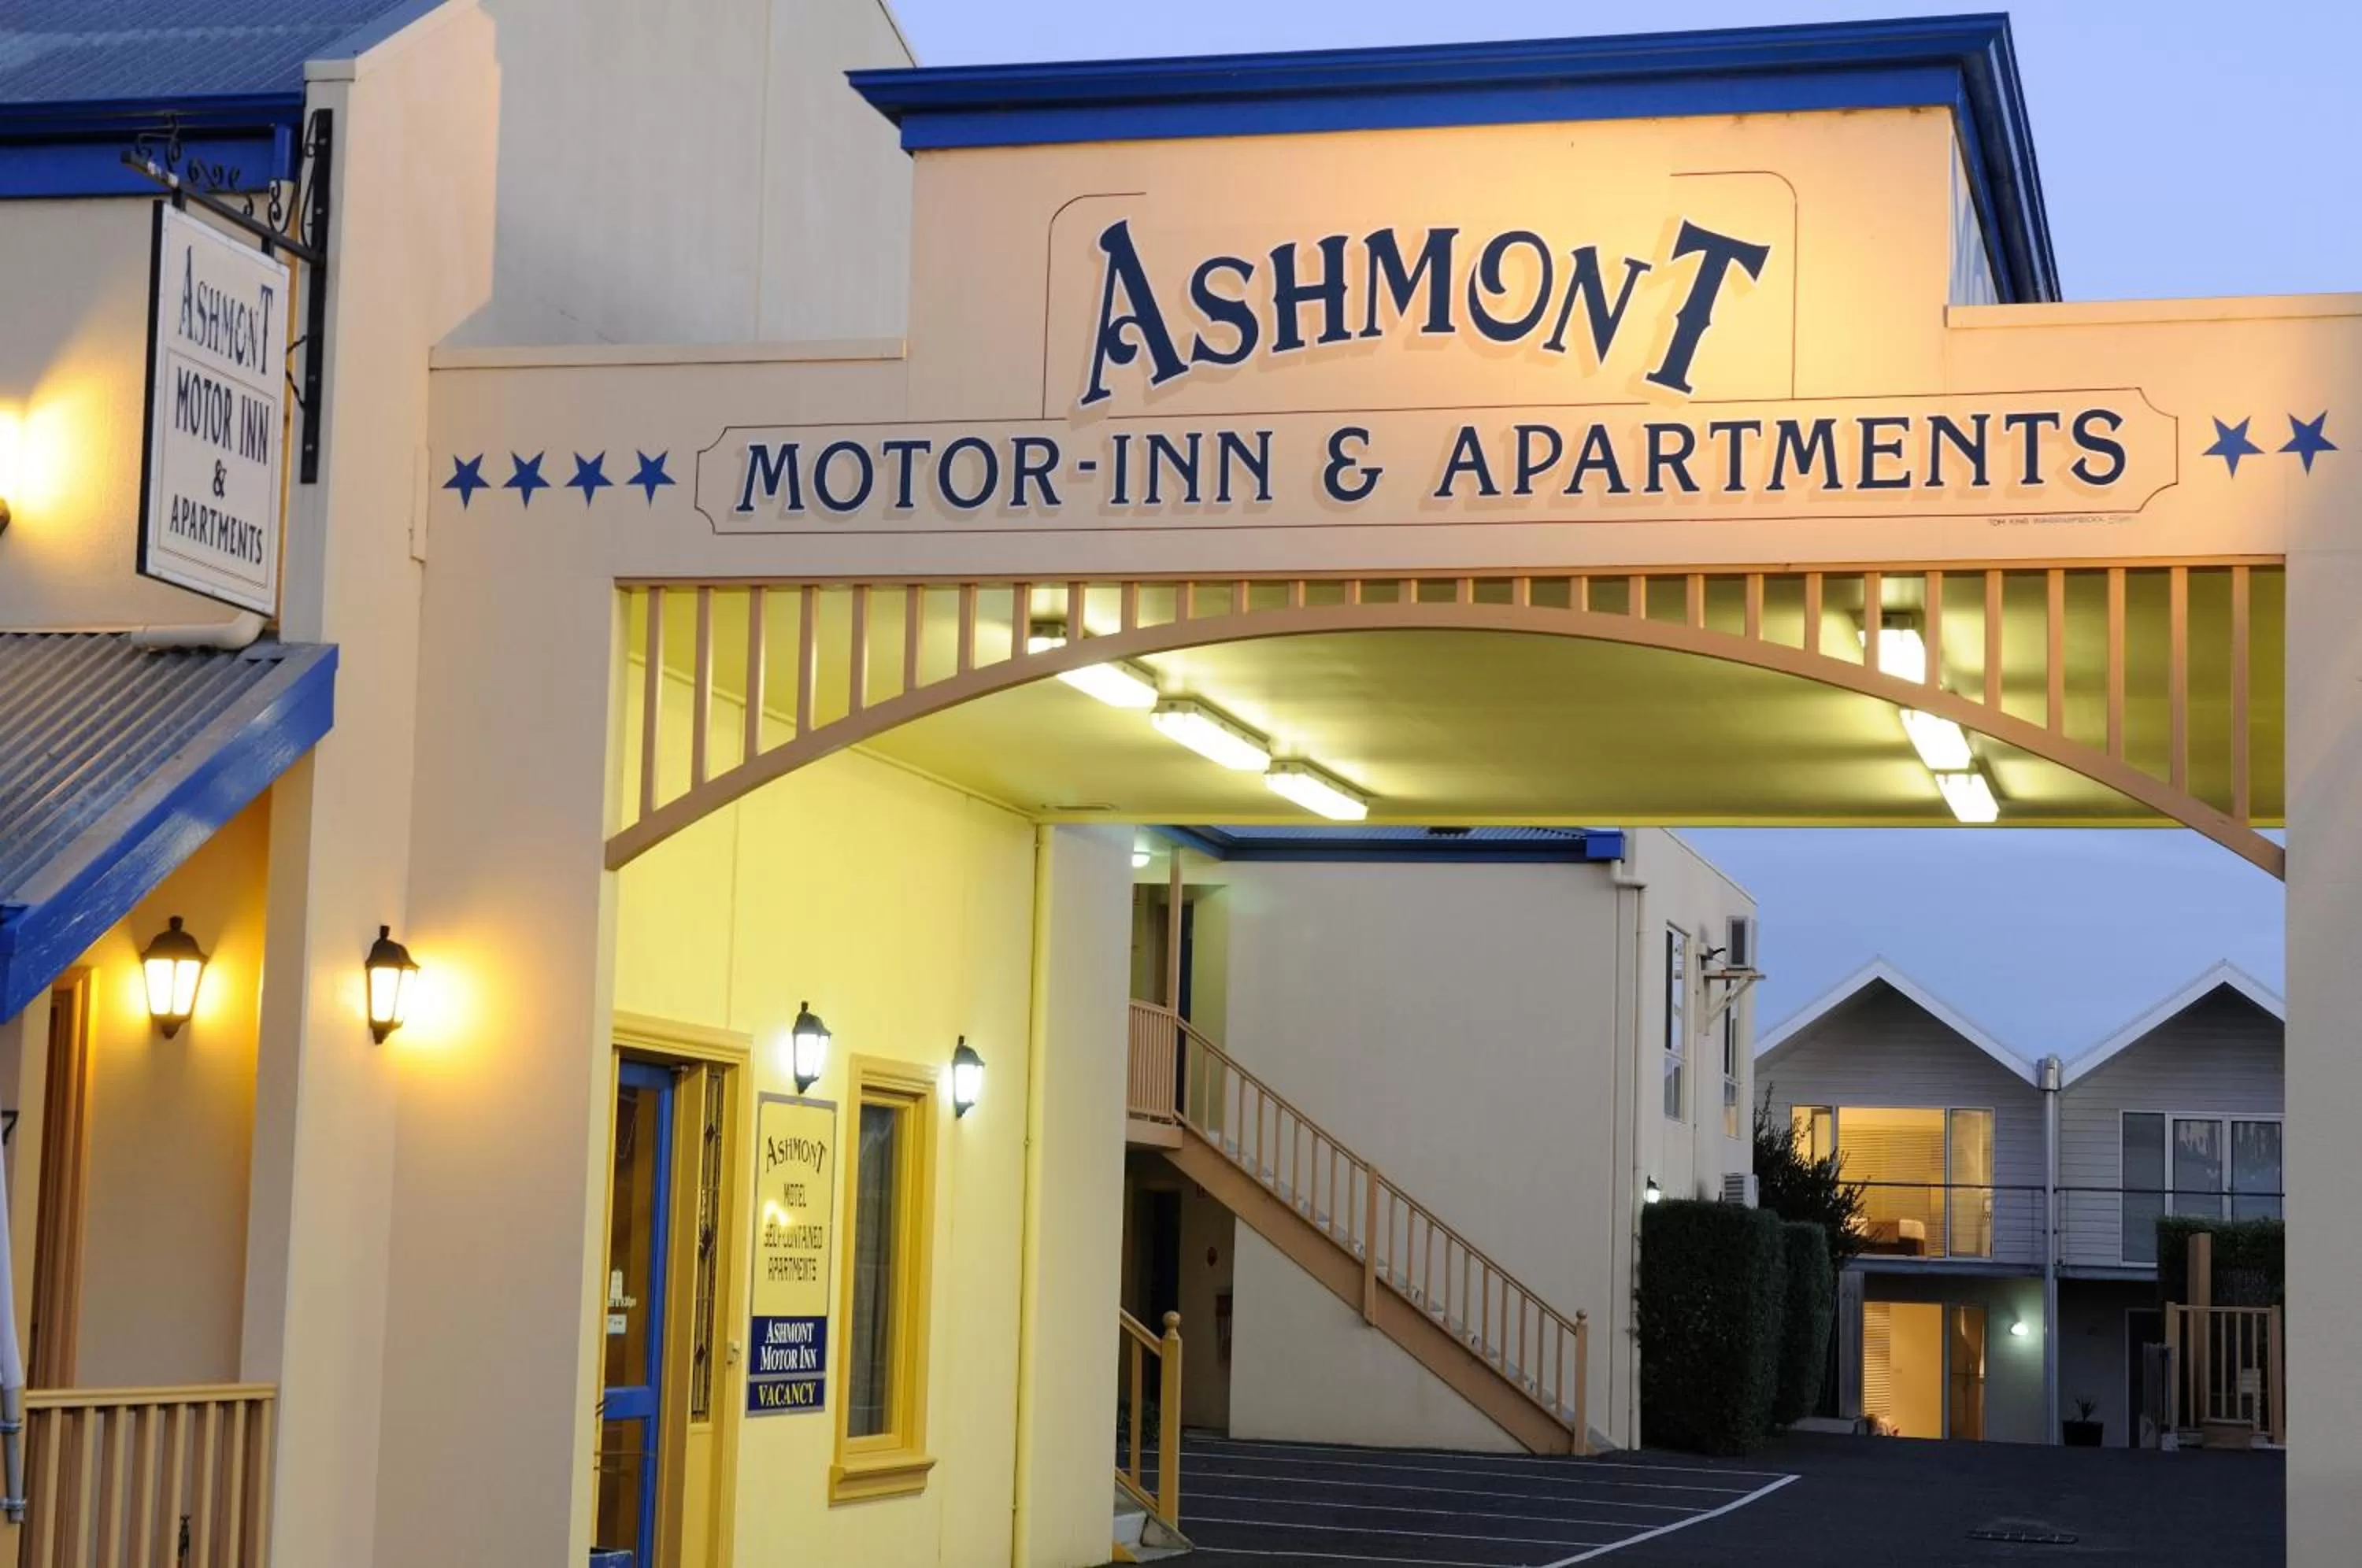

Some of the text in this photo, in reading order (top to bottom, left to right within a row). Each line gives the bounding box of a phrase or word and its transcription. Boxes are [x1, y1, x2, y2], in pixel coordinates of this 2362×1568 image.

[179, 246, 273, 375] ASHMONT
[1079, 218, 1772, 407] ASHMONT
[175, 366, 269, 466] MOTOR INN
[213, 459, 227, 498] &
[735, 407, 2128, 513] MOTOR-INN & APARTMENTS
[169, 494, 264, 566] APARTMENTS
[765, 1134, 827, 1174] ASHMONT
[783, 1182, 808, 1208] MOTEL
[768, 1257, 817, 1283] APARTMENTS
[765, 1318, 815, 1345] ASHMONT
[759, 1346, 817, 1372] MOTOR INN
[758, 1381, 816, 1407] VACANCY
